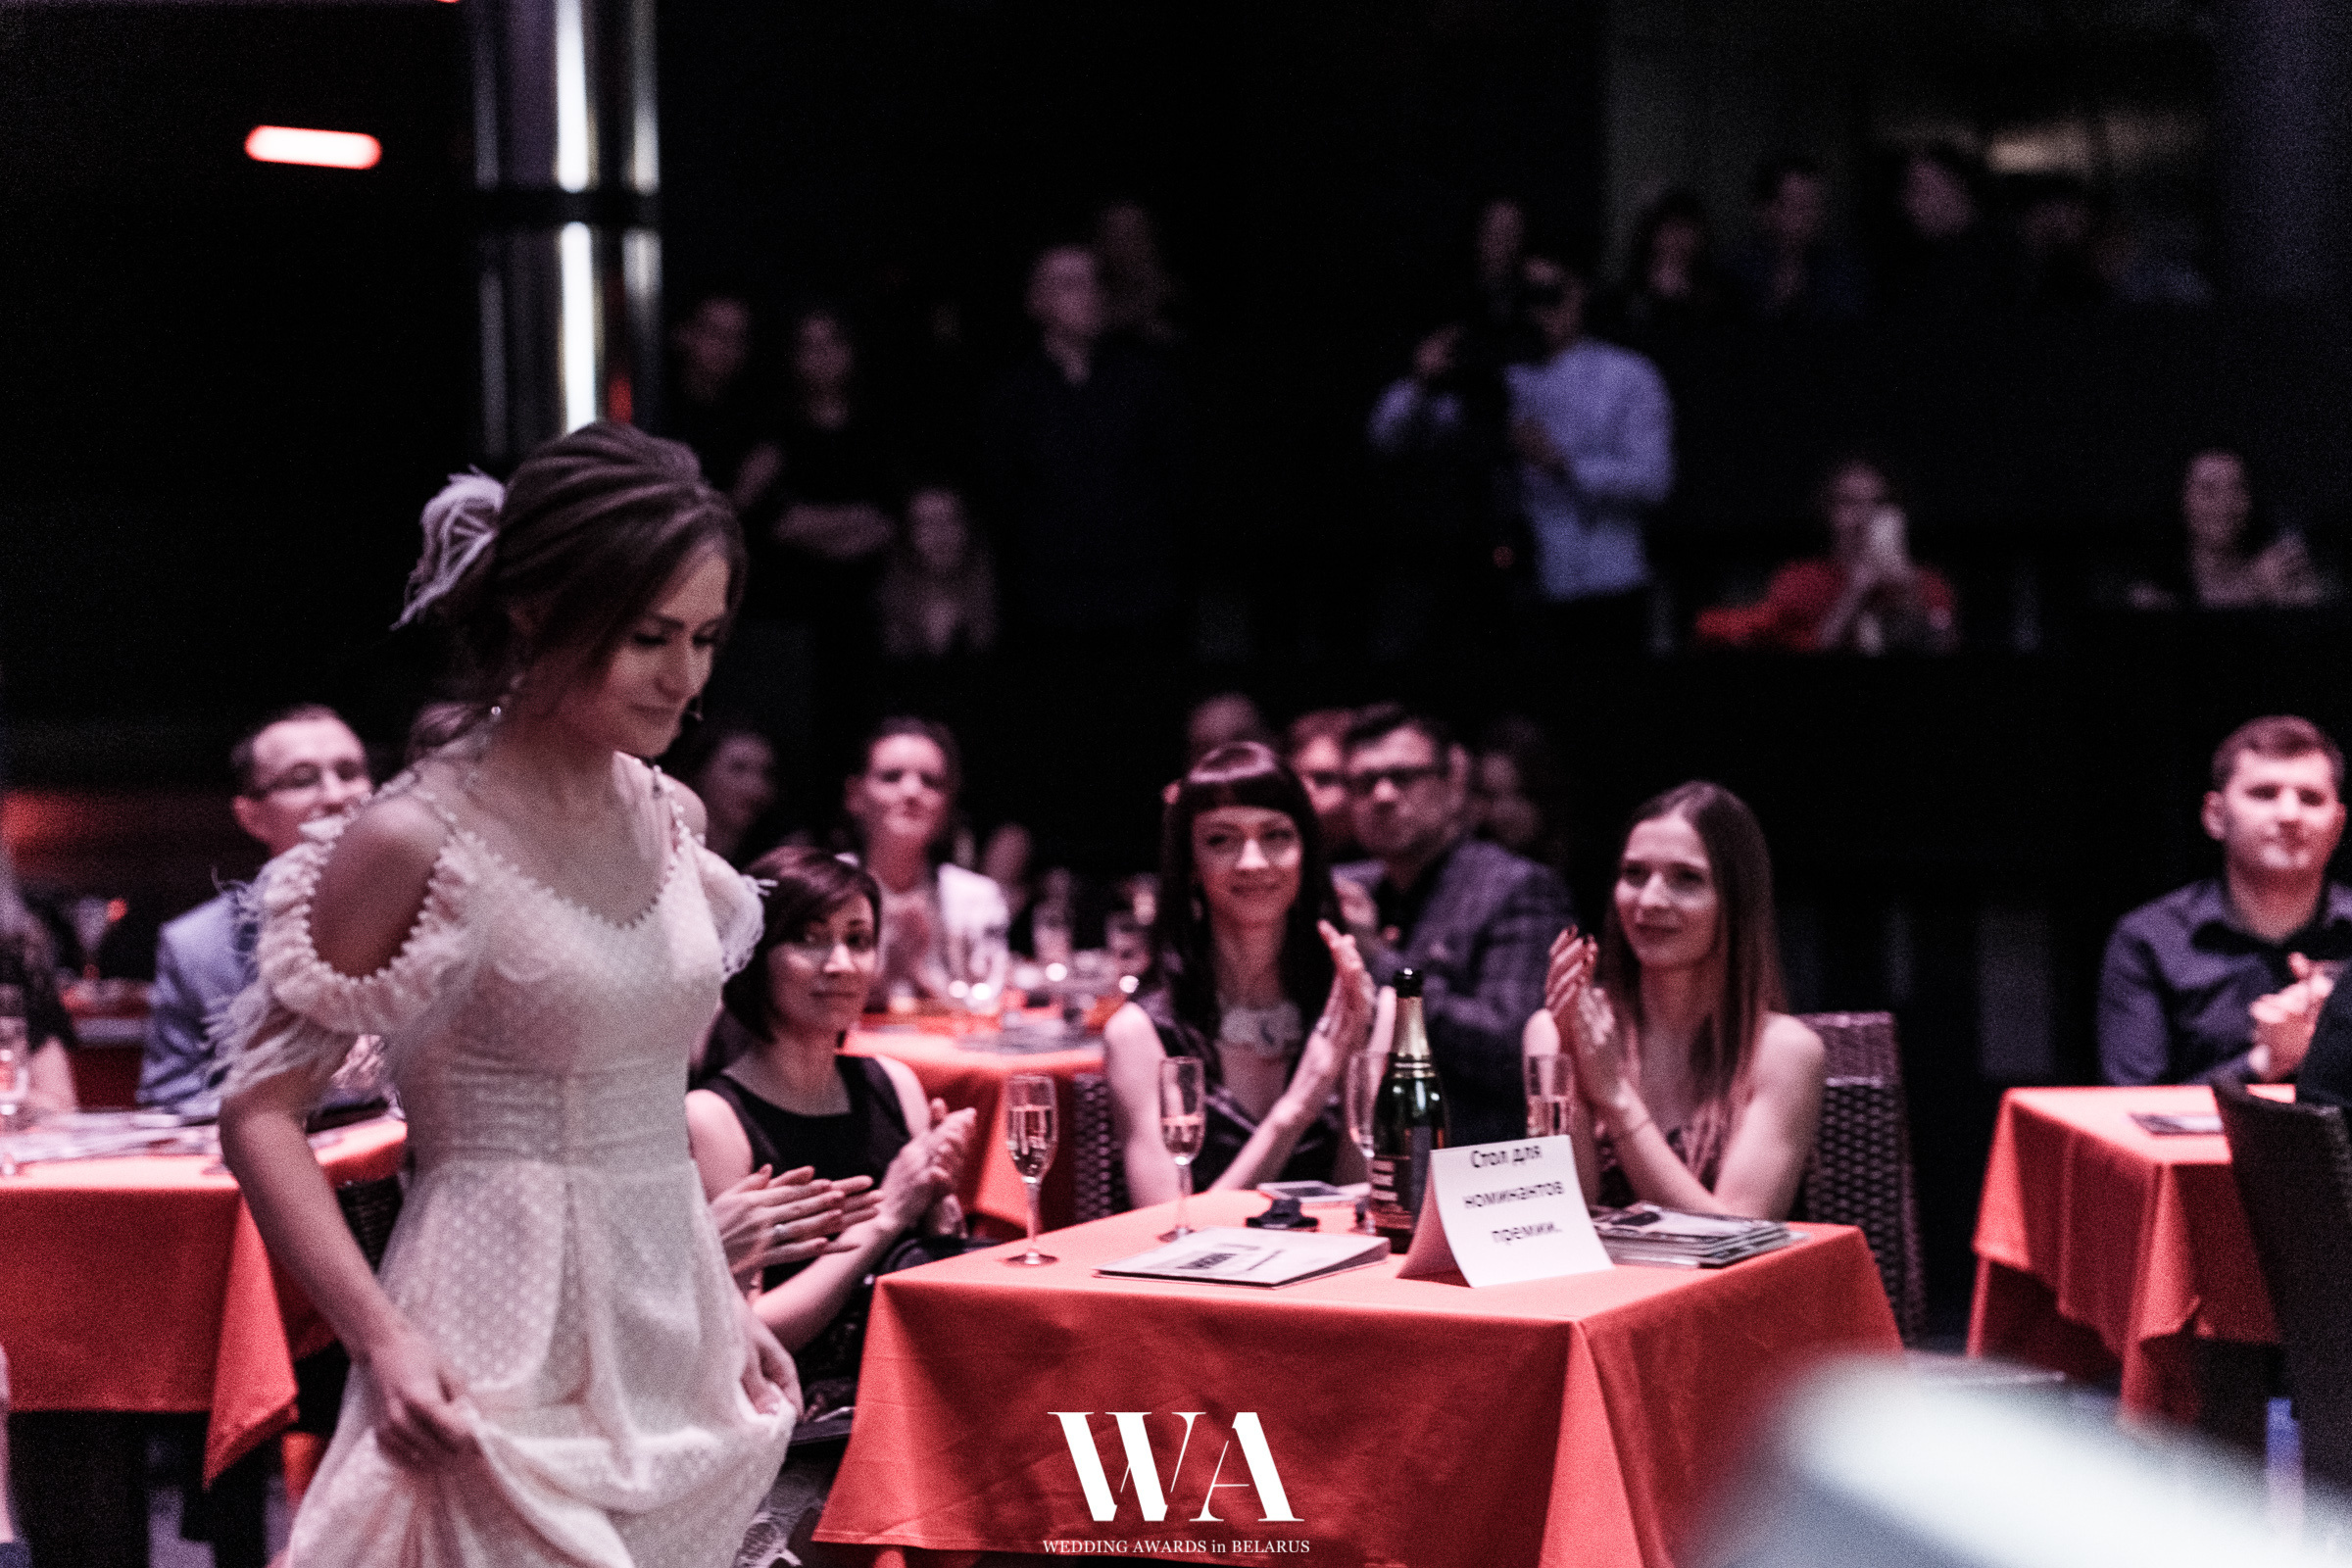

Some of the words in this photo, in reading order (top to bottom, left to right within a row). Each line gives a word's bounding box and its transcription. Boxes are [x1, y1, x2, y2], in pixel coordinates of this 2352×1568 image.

[1470, 1150, 1509, 1168] Стол
[1512, 1145, 1543, 1167] для
[1462, 1181, 1565, 1209] номинантов
